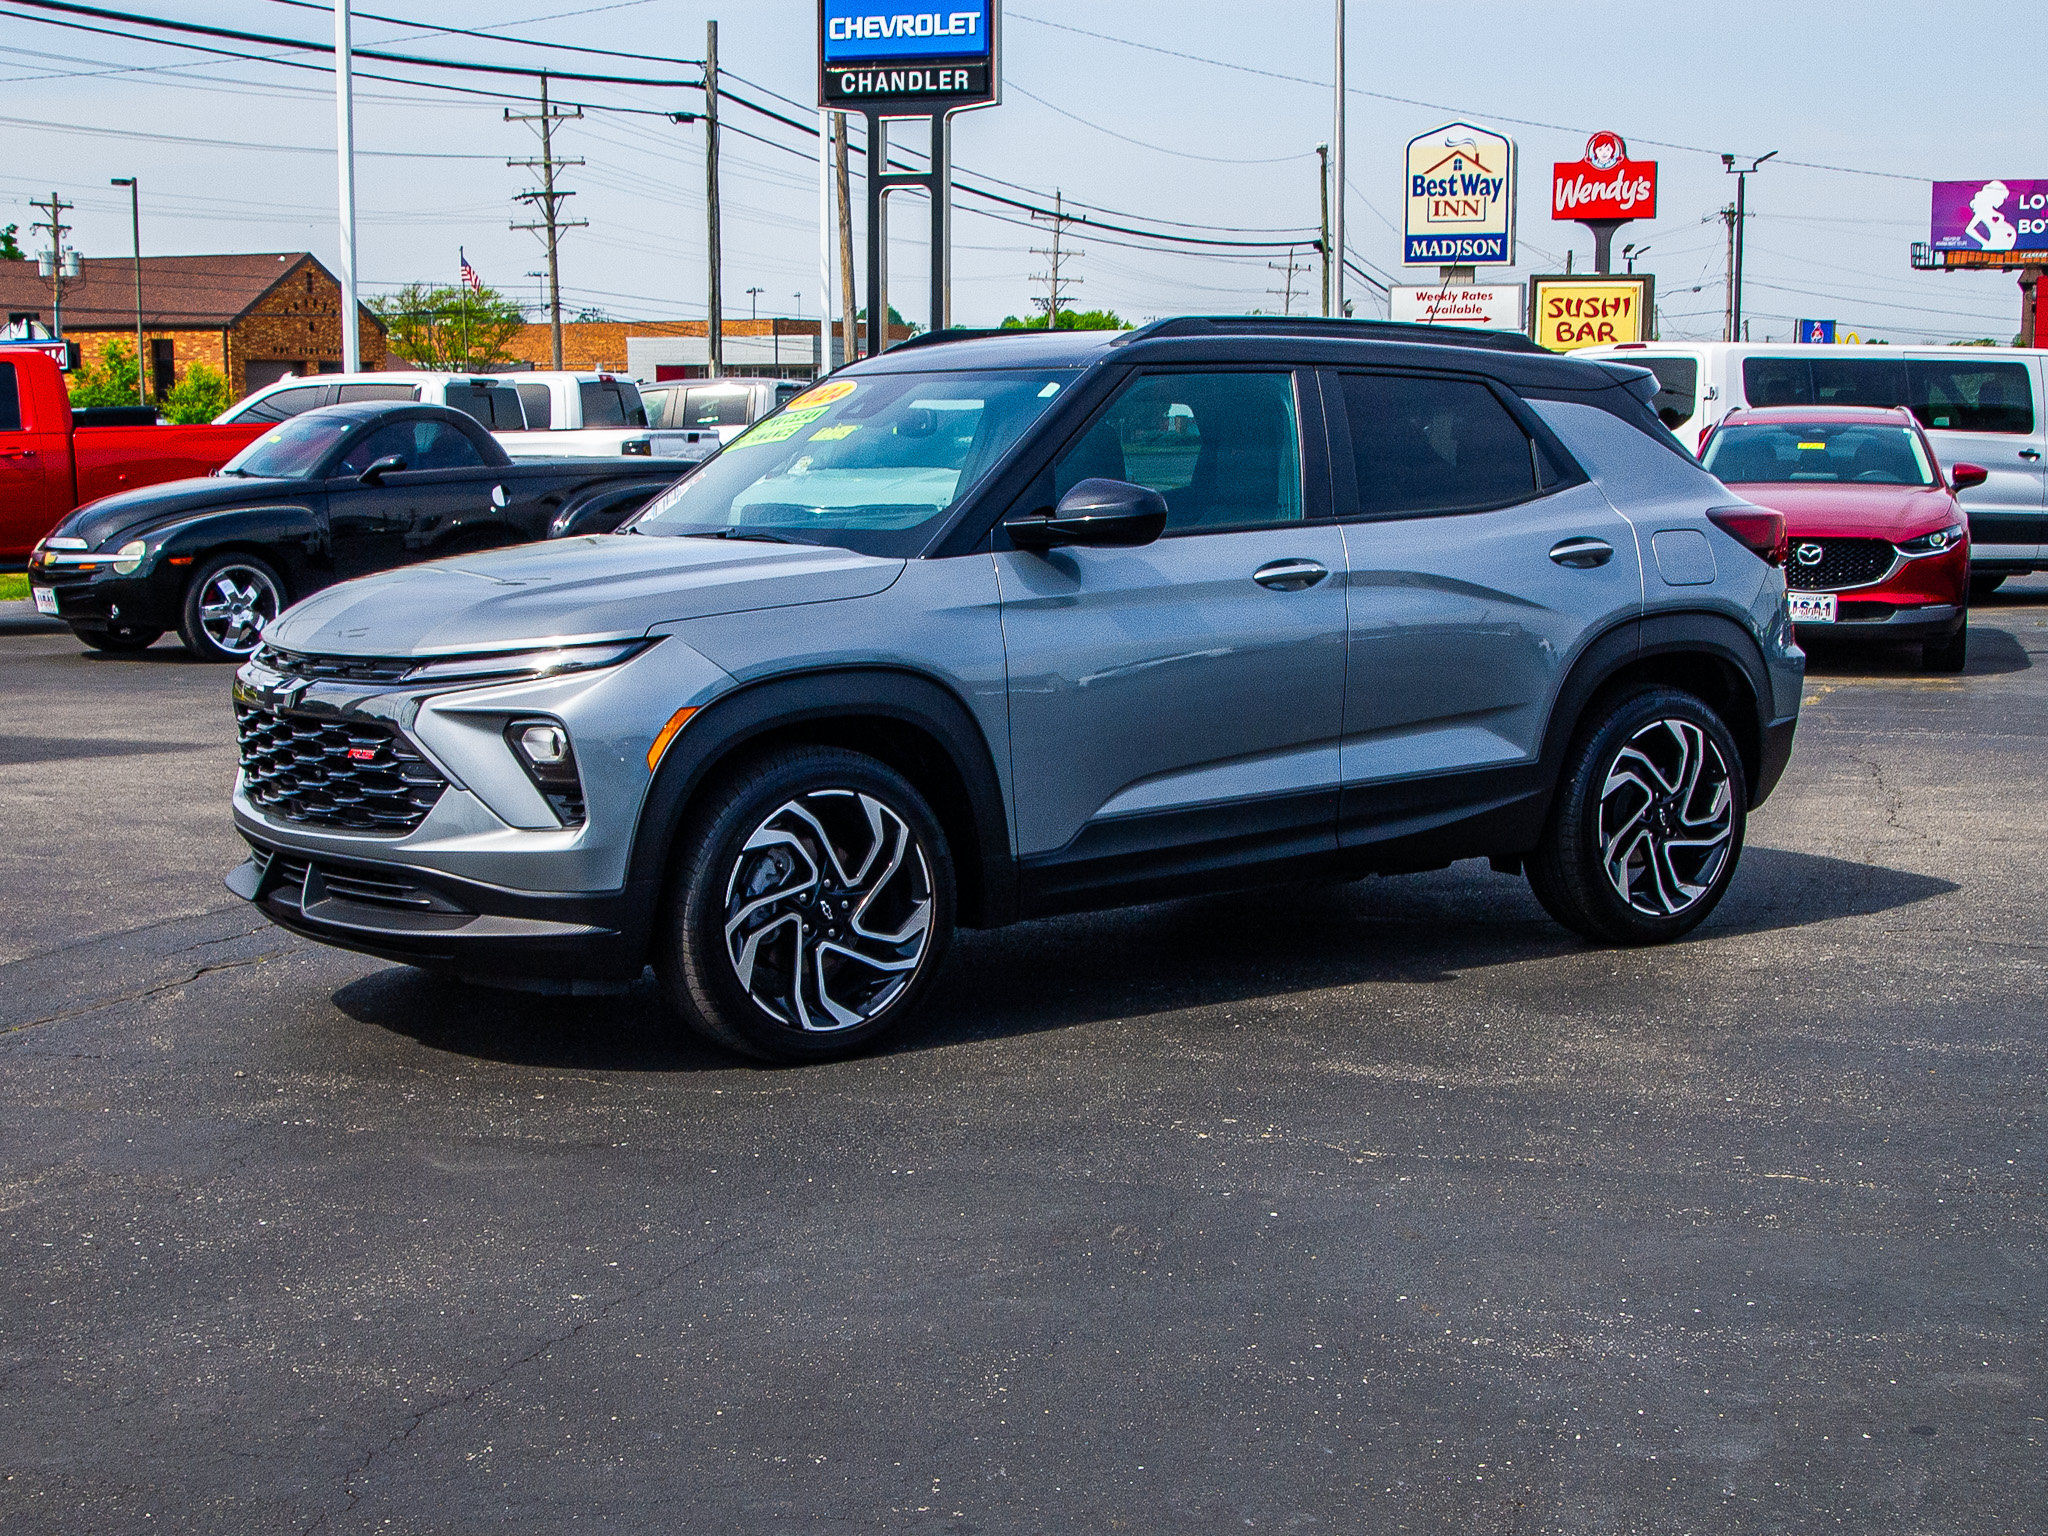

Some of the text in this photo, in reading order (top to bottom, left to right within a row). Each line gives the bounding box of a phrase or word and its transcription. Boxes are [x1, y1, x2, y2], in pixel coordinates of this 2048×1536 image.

[829, 11, 981, 40] CHEVROLET
[841, 69, 969, 94] CHANDLER
[1412, 173, 1504, 203] Best Way
[1555, 168, 1652, 212] Wendy's
[1432, 199, 1481, 218] INN
[2018, 193, 2048, 210] LO
[1410, 238, 1503, 258] MADISON
[1416, 290, 1493, 303] Weekly Rates
[1425, 303, 1483, 315] Available
[1547, 296, 1631, 319] SUSHI
[1556, 321, 1618, 343] BAR
[347, 748, 376, 760] RS
